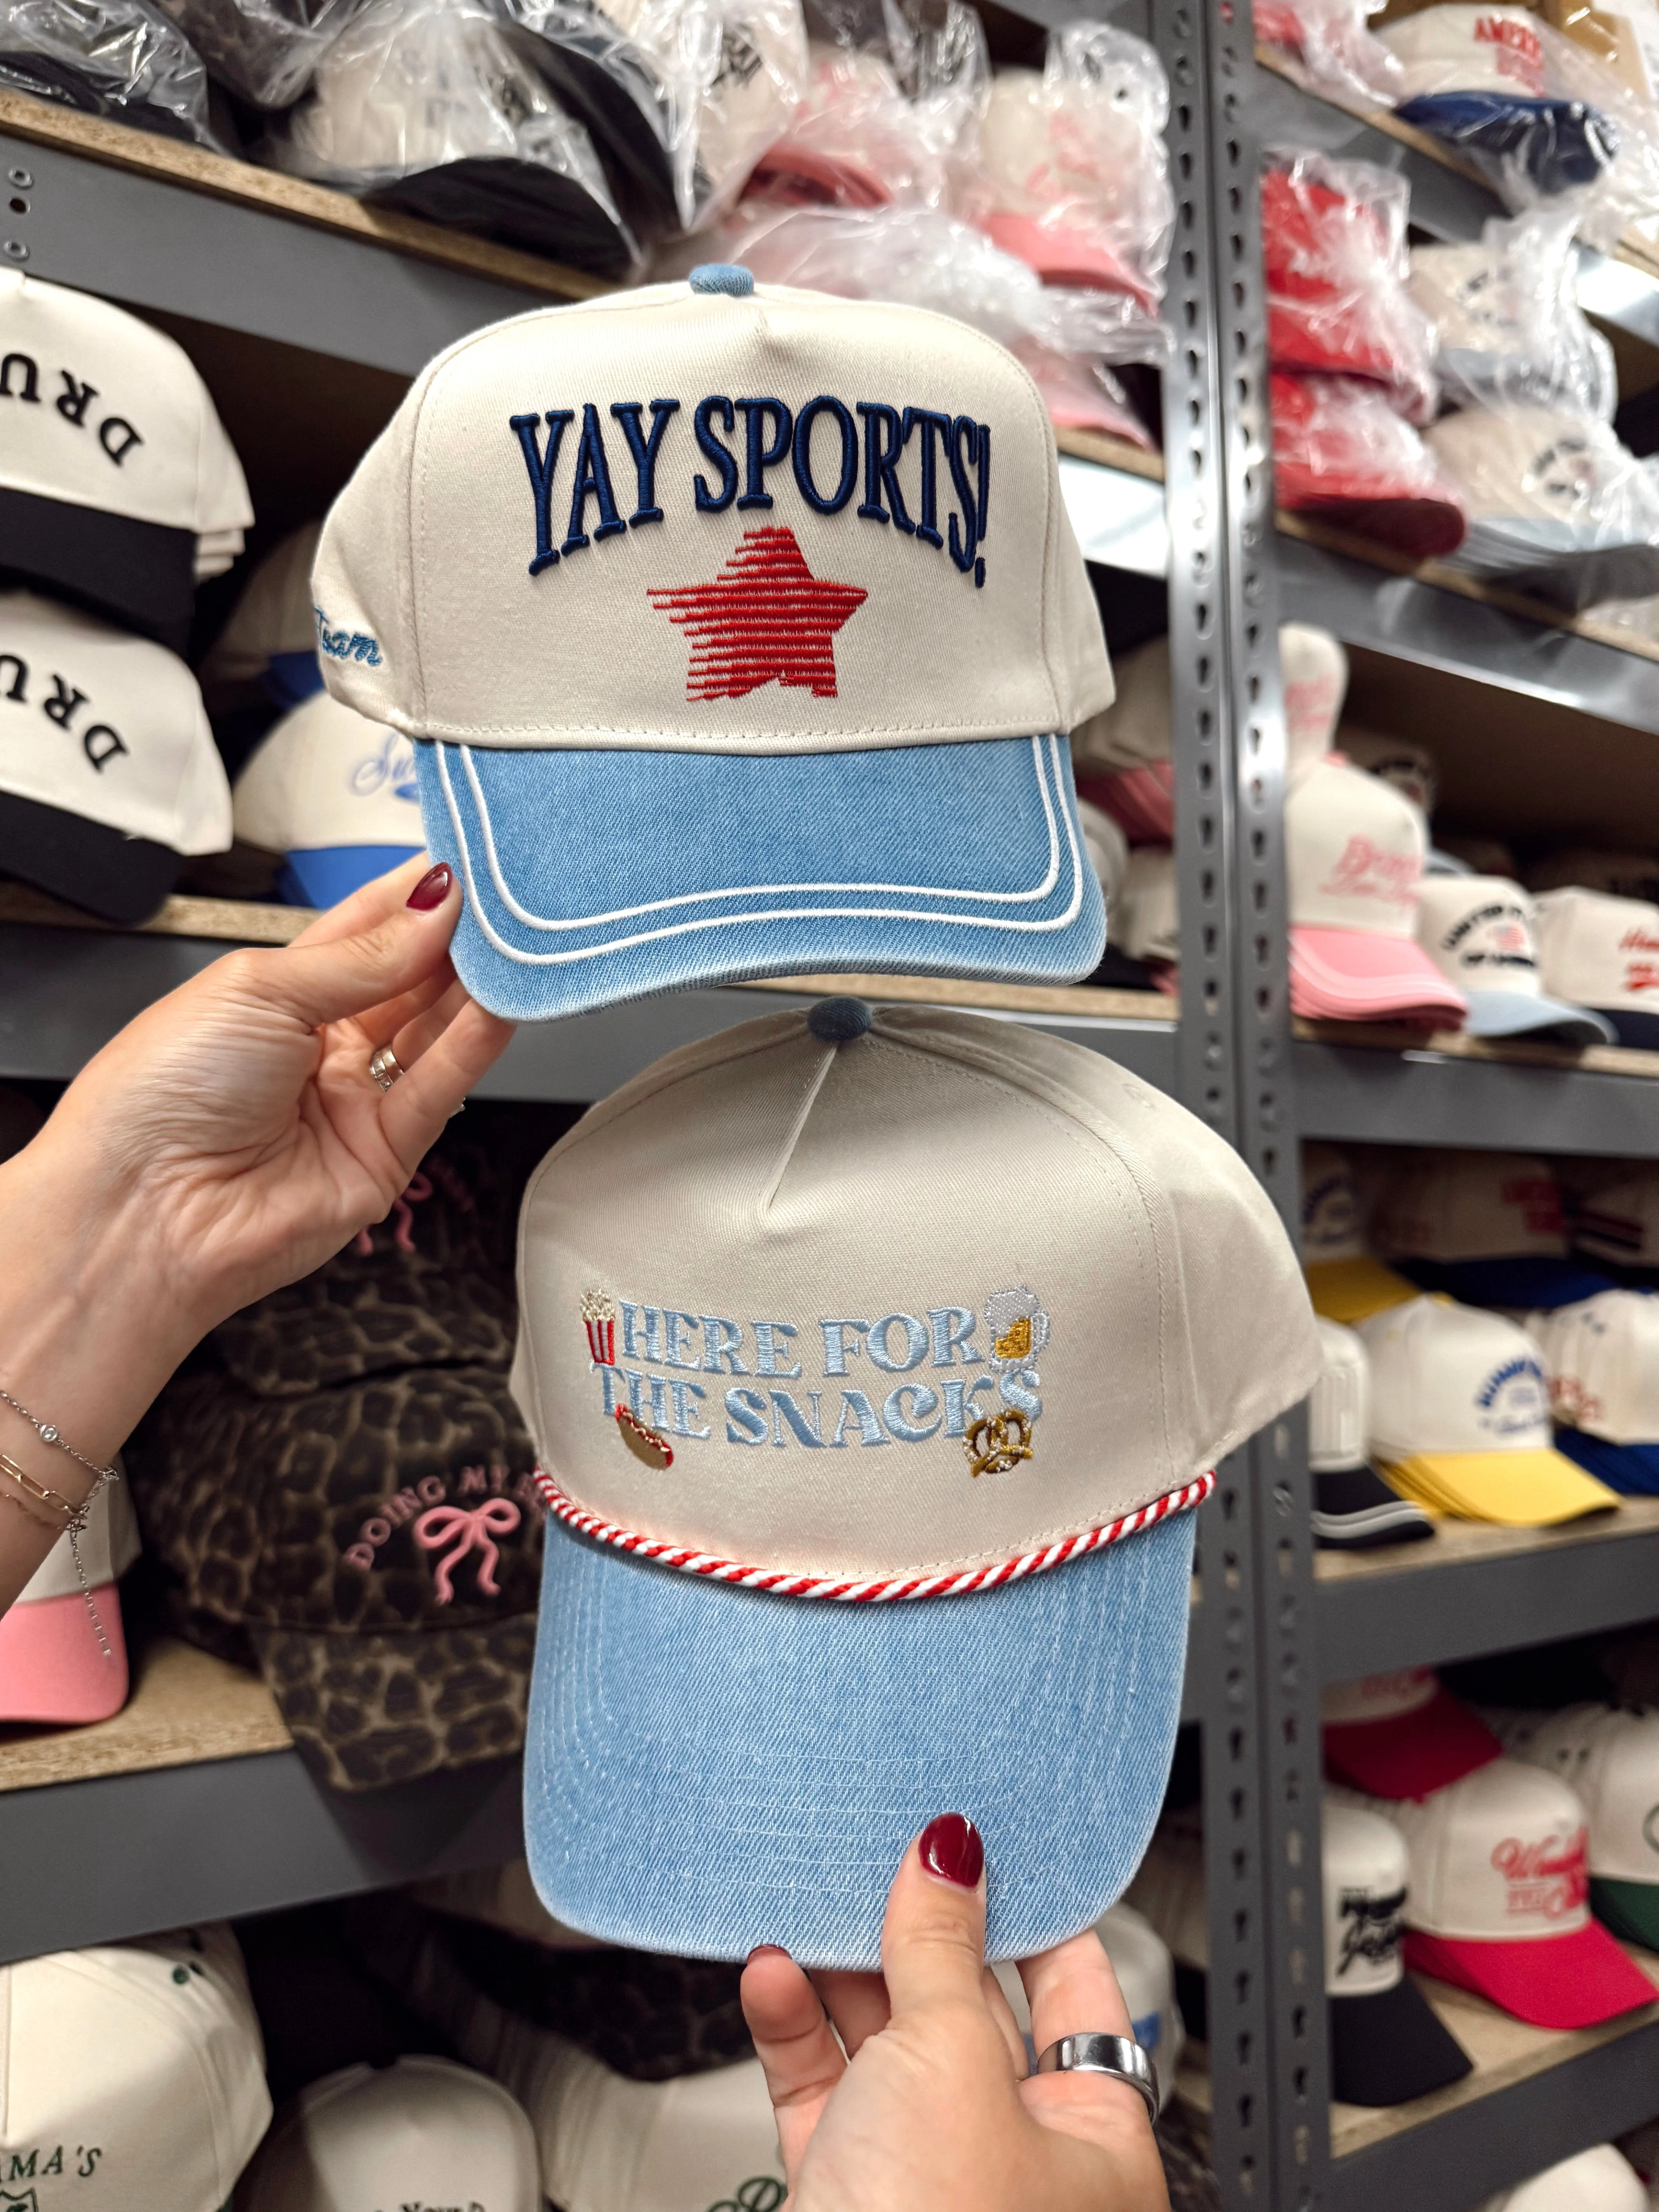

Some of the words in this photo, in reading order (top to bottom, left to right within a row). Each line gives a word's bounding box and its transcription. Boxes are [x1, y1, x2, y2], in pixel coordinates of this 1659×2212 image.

[509, 398, 680, 577] YAY
[692, 394, 991, 589] SPORTS!
[620, 1300, 802, 1379] HERE
[820, 1306, 986, 1377] FOR
[589, 1358, 711, 1439] THE
[723, 1368, 1043, 1449] SNACKS
[345, 1475, 447, 1573] DOING
[0, 2144, 102, 2182] MA'S
